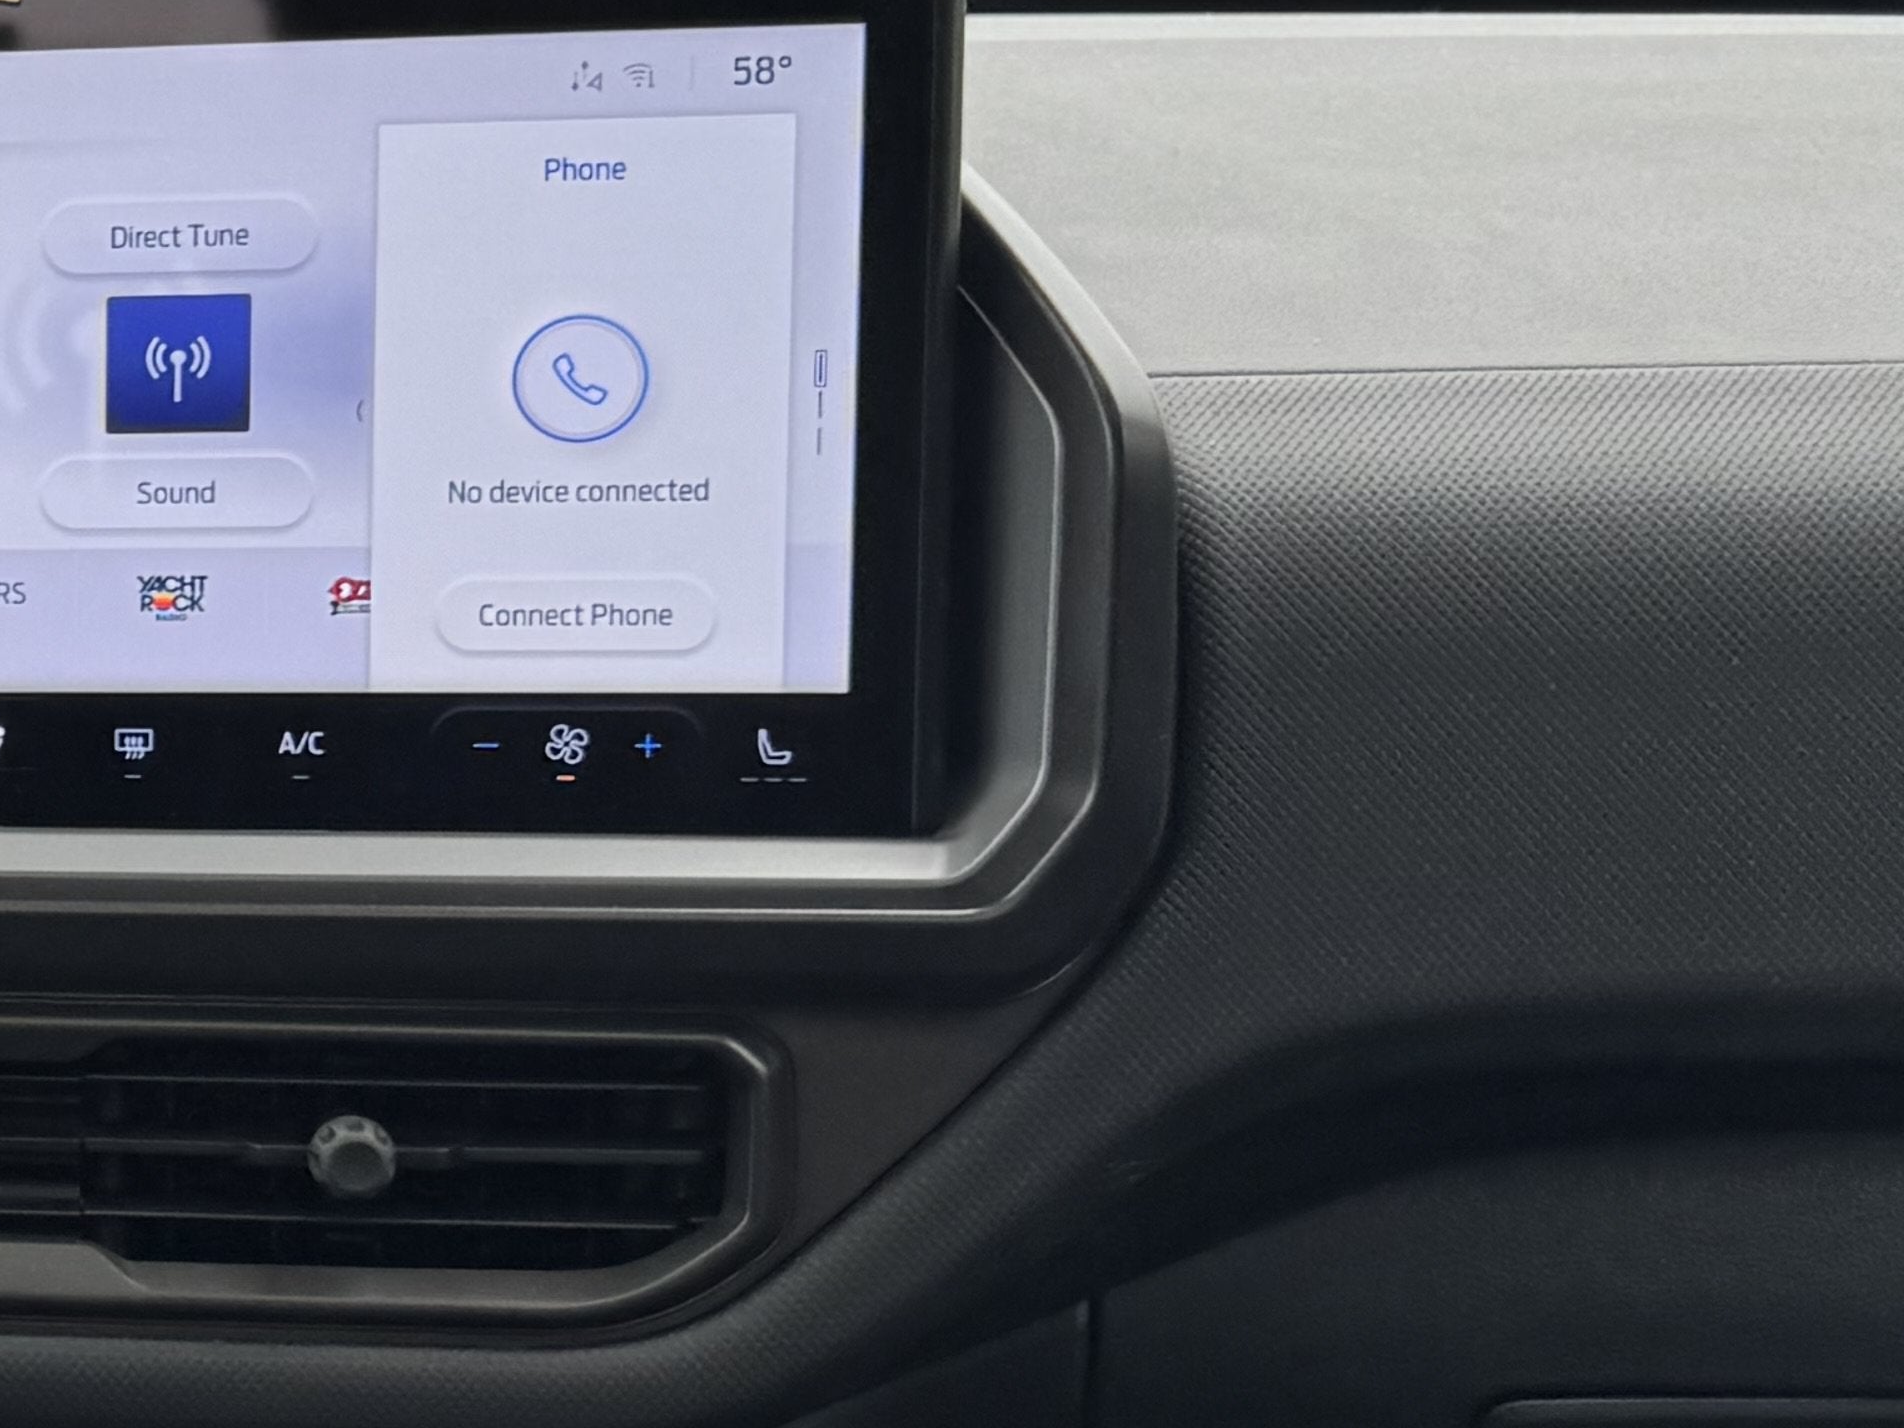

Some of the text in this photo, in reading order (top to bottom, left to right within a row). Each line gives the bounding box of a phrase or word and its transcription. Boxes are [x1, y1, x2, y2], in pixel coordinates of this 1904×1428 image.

[732, 55, 793, 86] 58°
[544, 157, 627, 183] Phone
[110, 224, 250, 250] Direct Tune
[136, 481, 216, 505] Sound
[448, 477, 711, 504] No device connected
[136, 575, 209, 593] YACHT
[478, 603, 674, 629] Connect Phone
[278, 731, 326, 756] A/C
